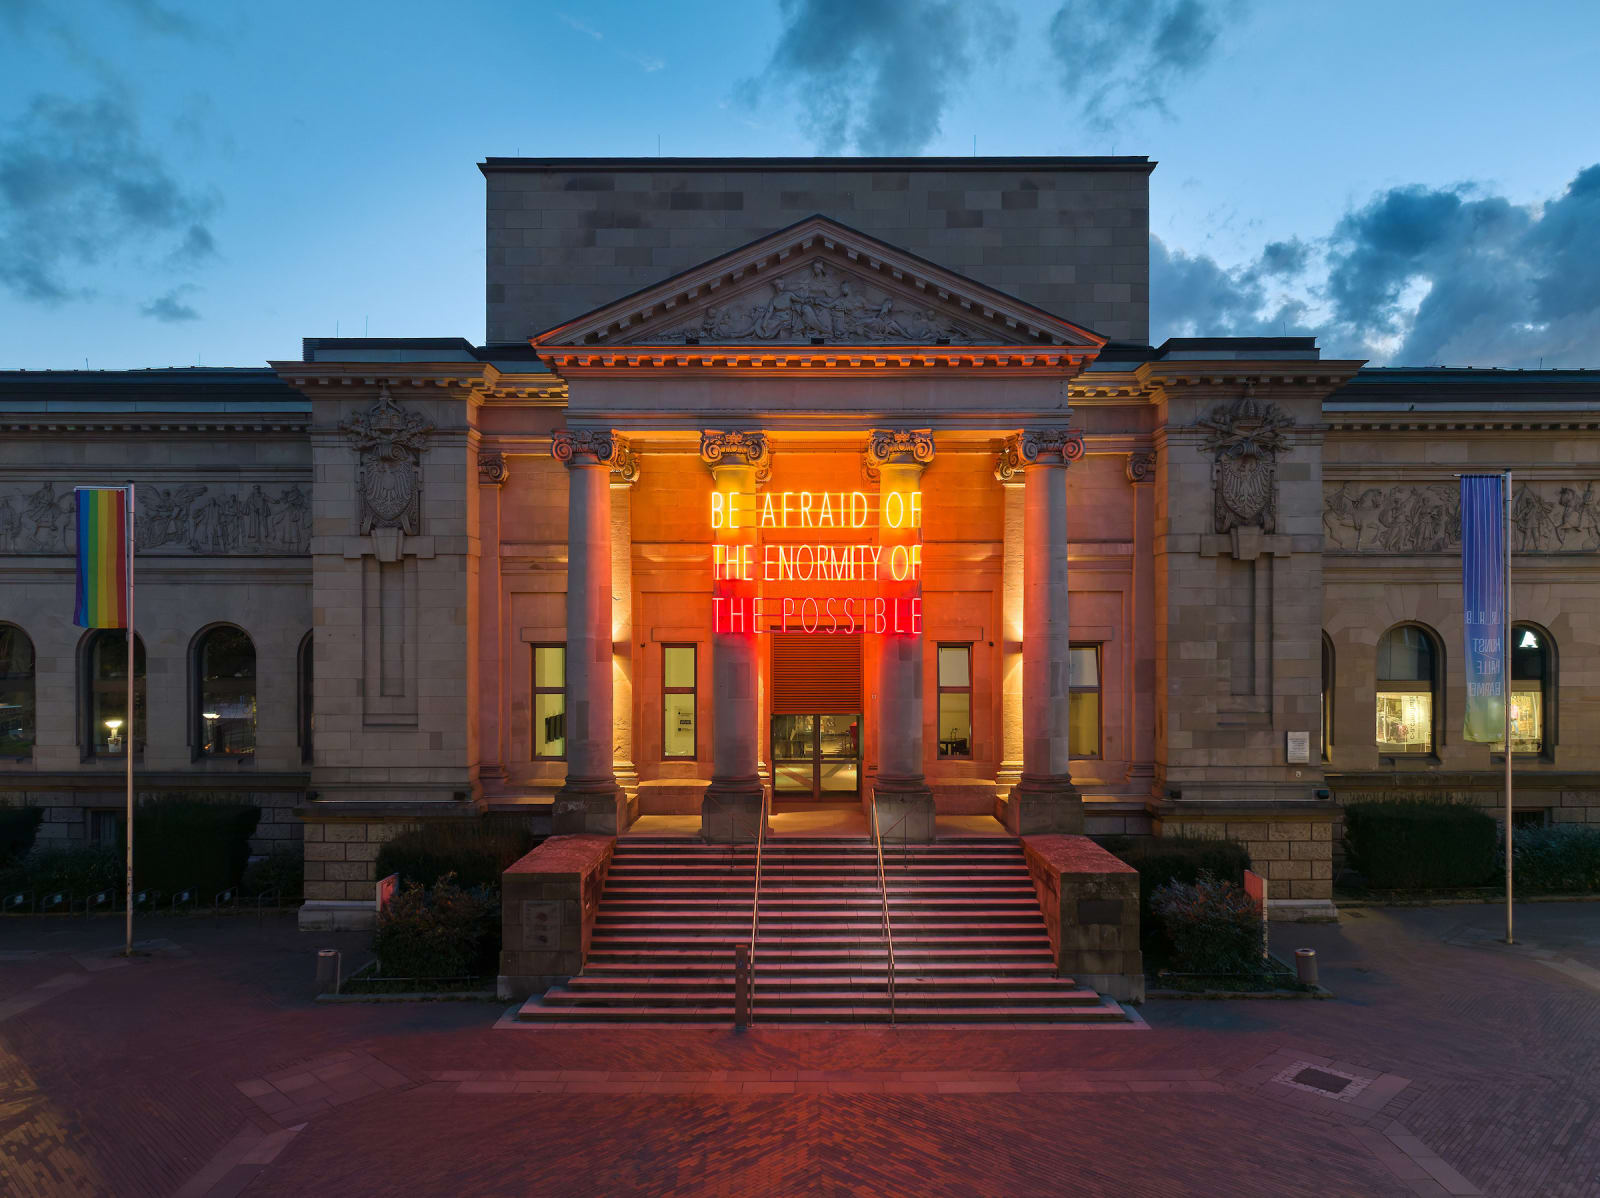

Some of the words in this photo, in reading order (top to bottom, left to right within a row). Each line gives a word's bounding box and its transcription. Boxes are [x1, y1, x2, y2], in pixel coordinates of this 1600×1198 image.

[711, 491, 740, 529] BE
[761, 491, 868, 529] AFRAID
[886, 491, 922, 529] OF
[711, 544, 753, 581] THE
[764, 544, 882, 581] ENORMITY
[891, 544, 922, 581] OF
[711, 597, 763, 634] THE
[782, 597, 922, 634] POSSIBLE
